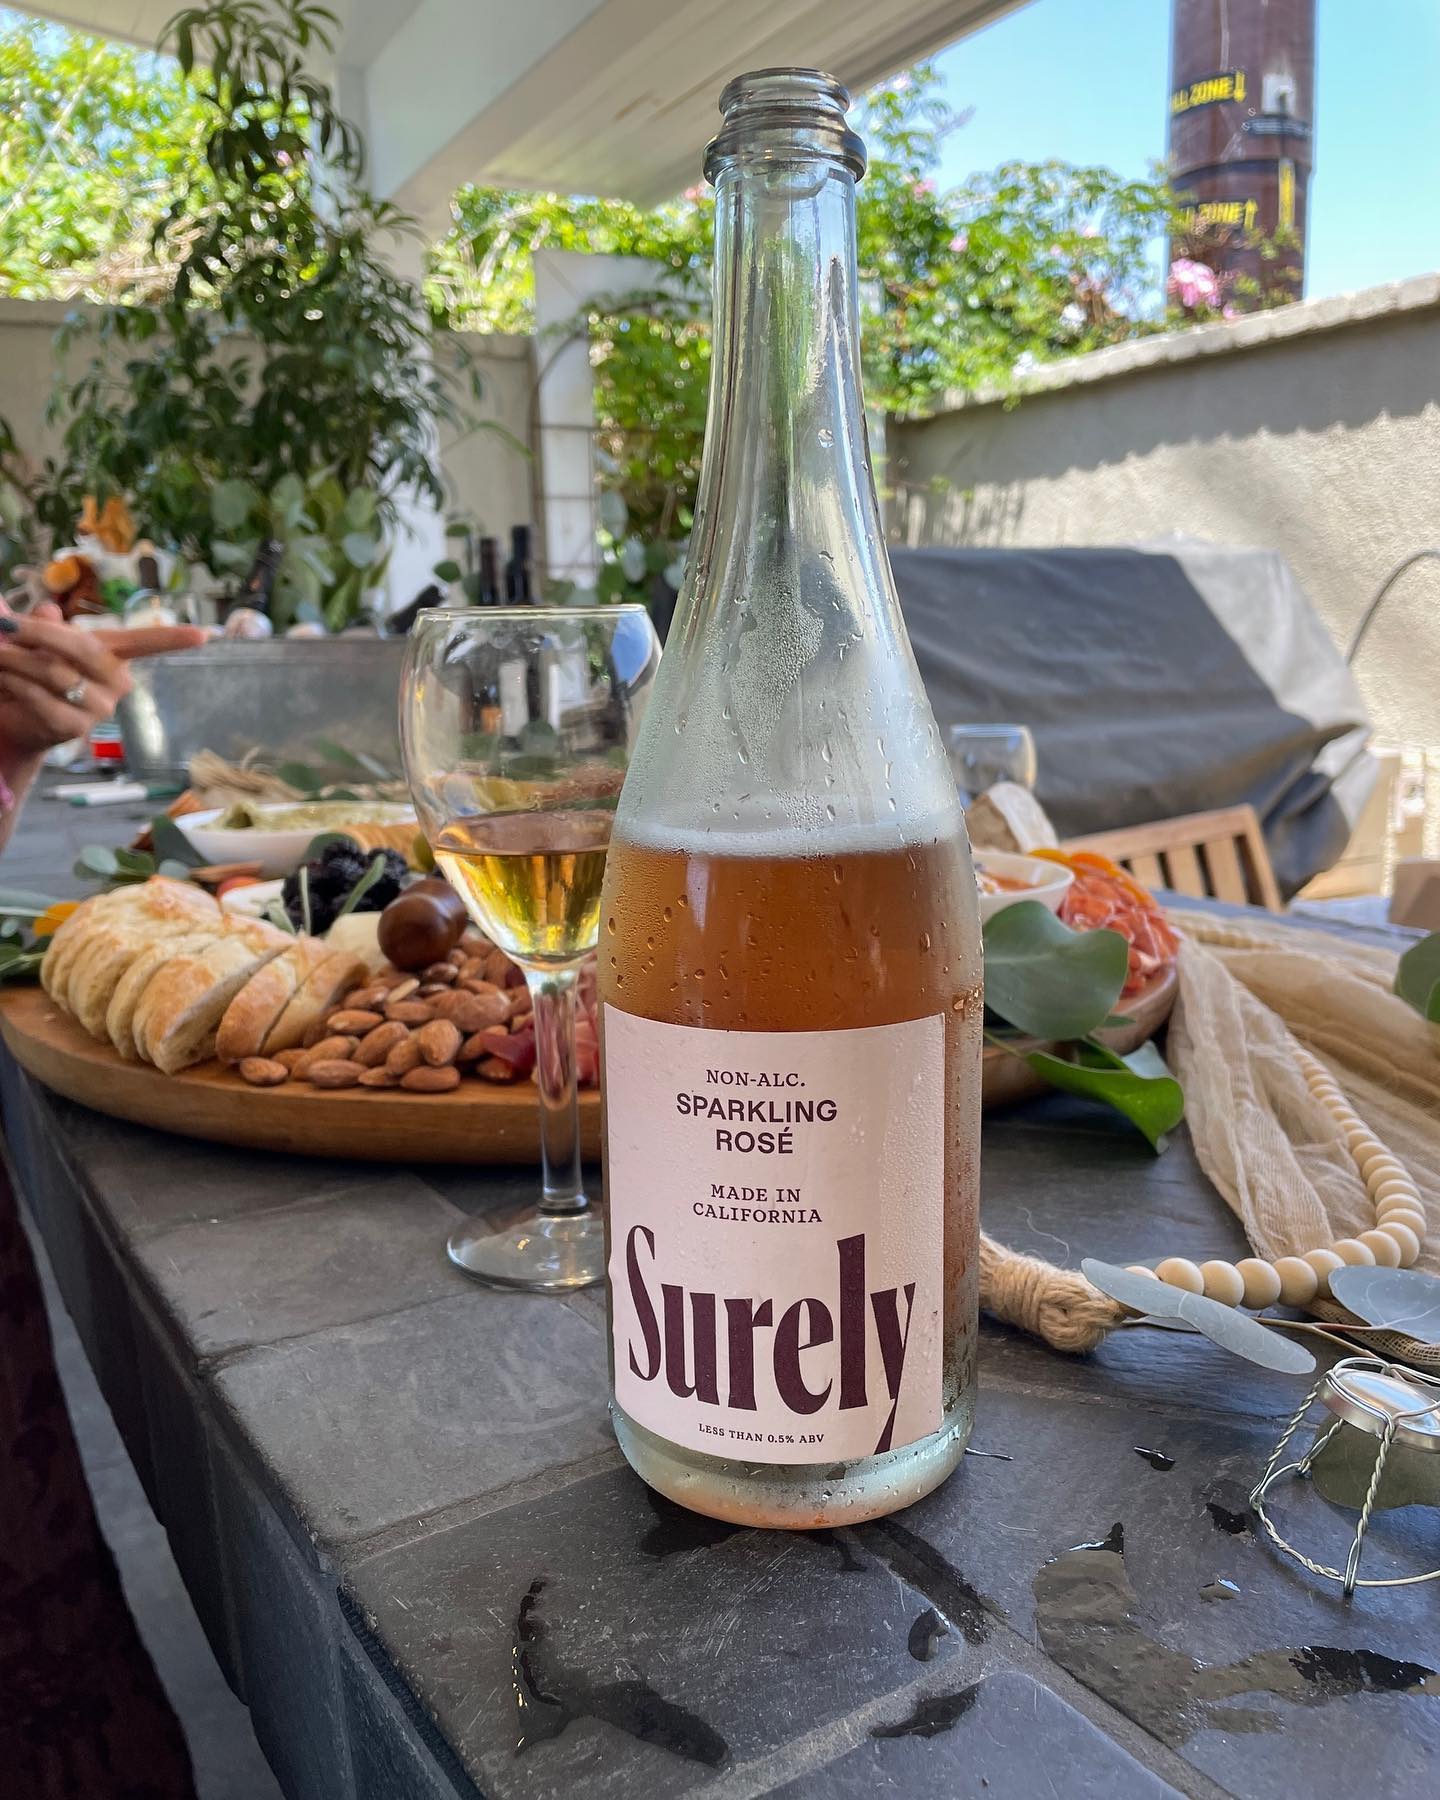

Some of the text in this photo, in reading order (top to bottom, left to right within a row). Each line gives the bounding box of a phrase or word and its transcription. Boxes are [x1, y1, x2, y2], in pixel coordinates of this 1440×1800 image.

[1189, 76, 1234, 107] ZONE
[705, 1069, 806, 1088] NON-ALC.
[676, 1092, 838, 1124] SPARKLING
[715, 1126, 794, 1155] ROSÉ
[710, 1183, 801, 1203] MADE IN
[692, 1202, 823, 1224] CALIFORNIA
[626, 1224, 916, 1456] Surely
[698, 1422, 825, 1445] LESS THAN 0.5% ABV
